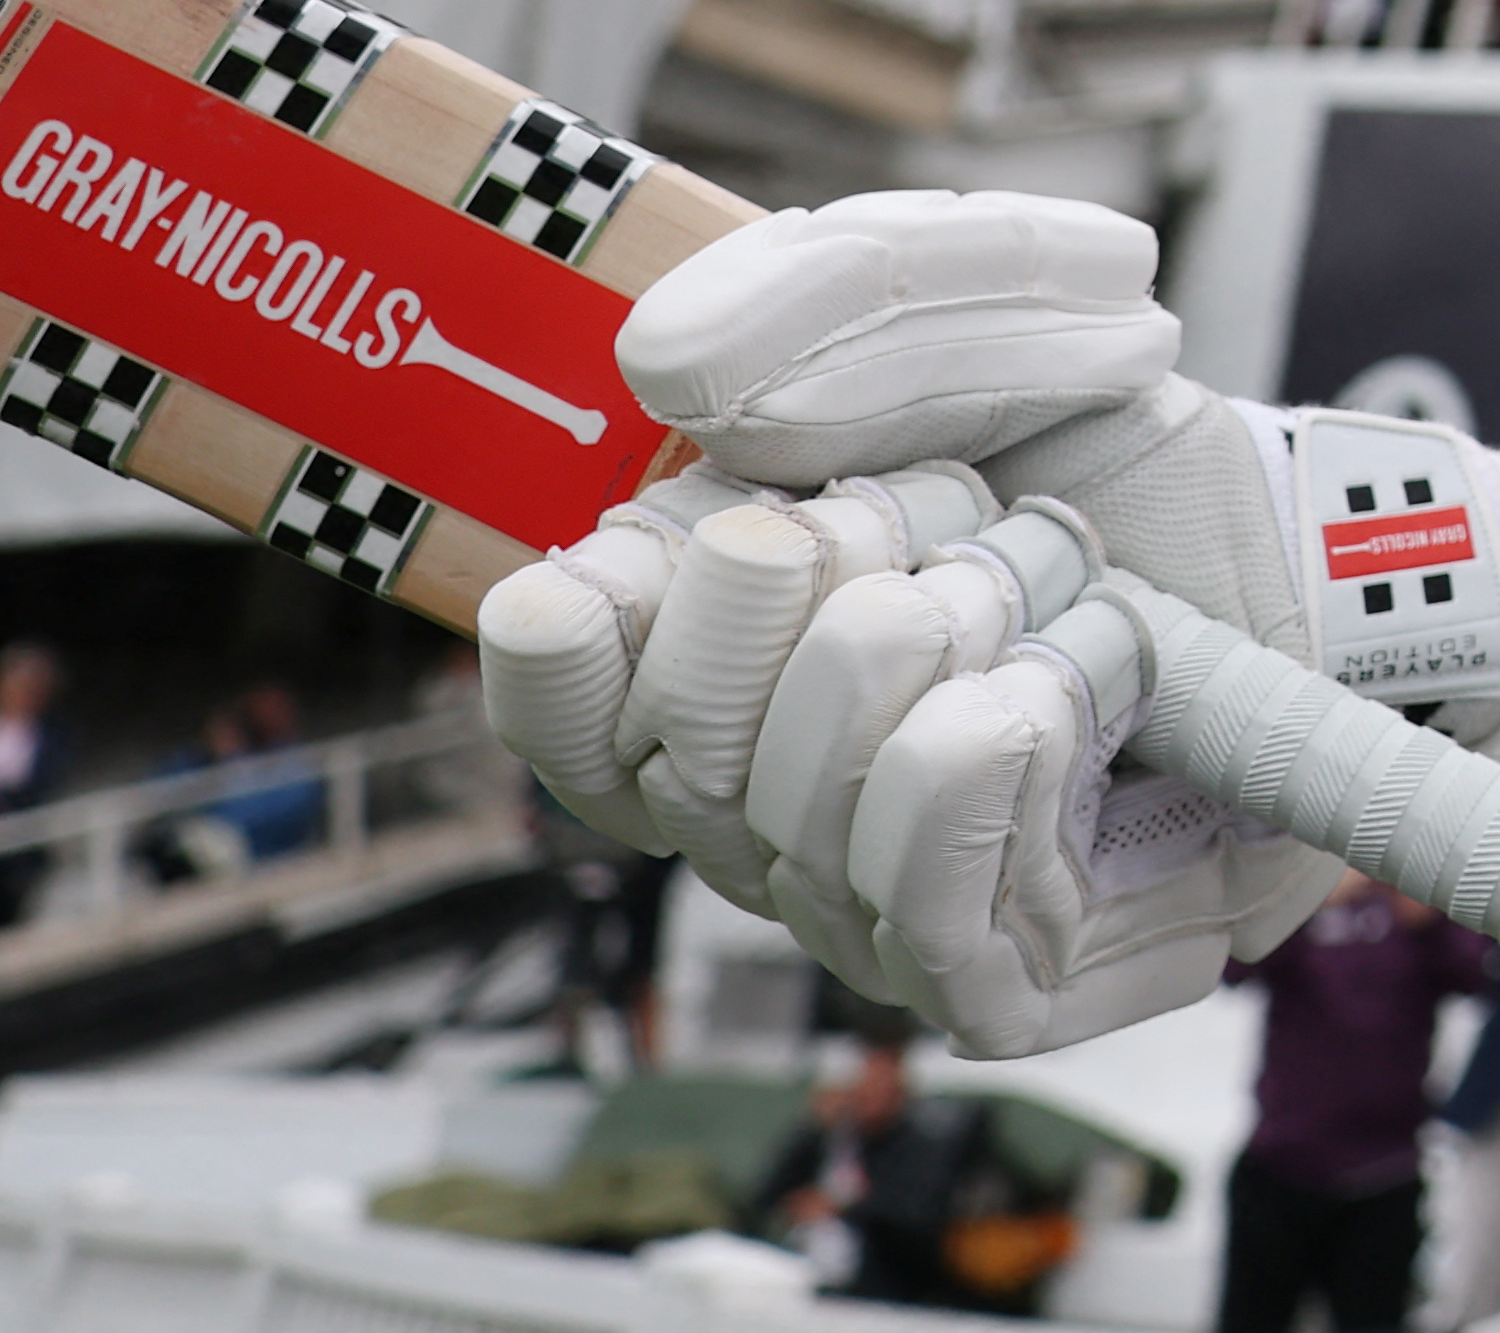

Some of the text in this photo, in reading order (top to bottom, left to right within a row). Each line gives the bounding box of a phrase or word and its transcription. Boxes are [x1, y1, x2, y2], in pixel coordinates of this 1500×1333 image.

[1, 119, 422, 370] GRAY-NICOLLS
[1345, 633, 1477, 668] EDITION
[1336, 651, 1487, 686] PLAYERS
